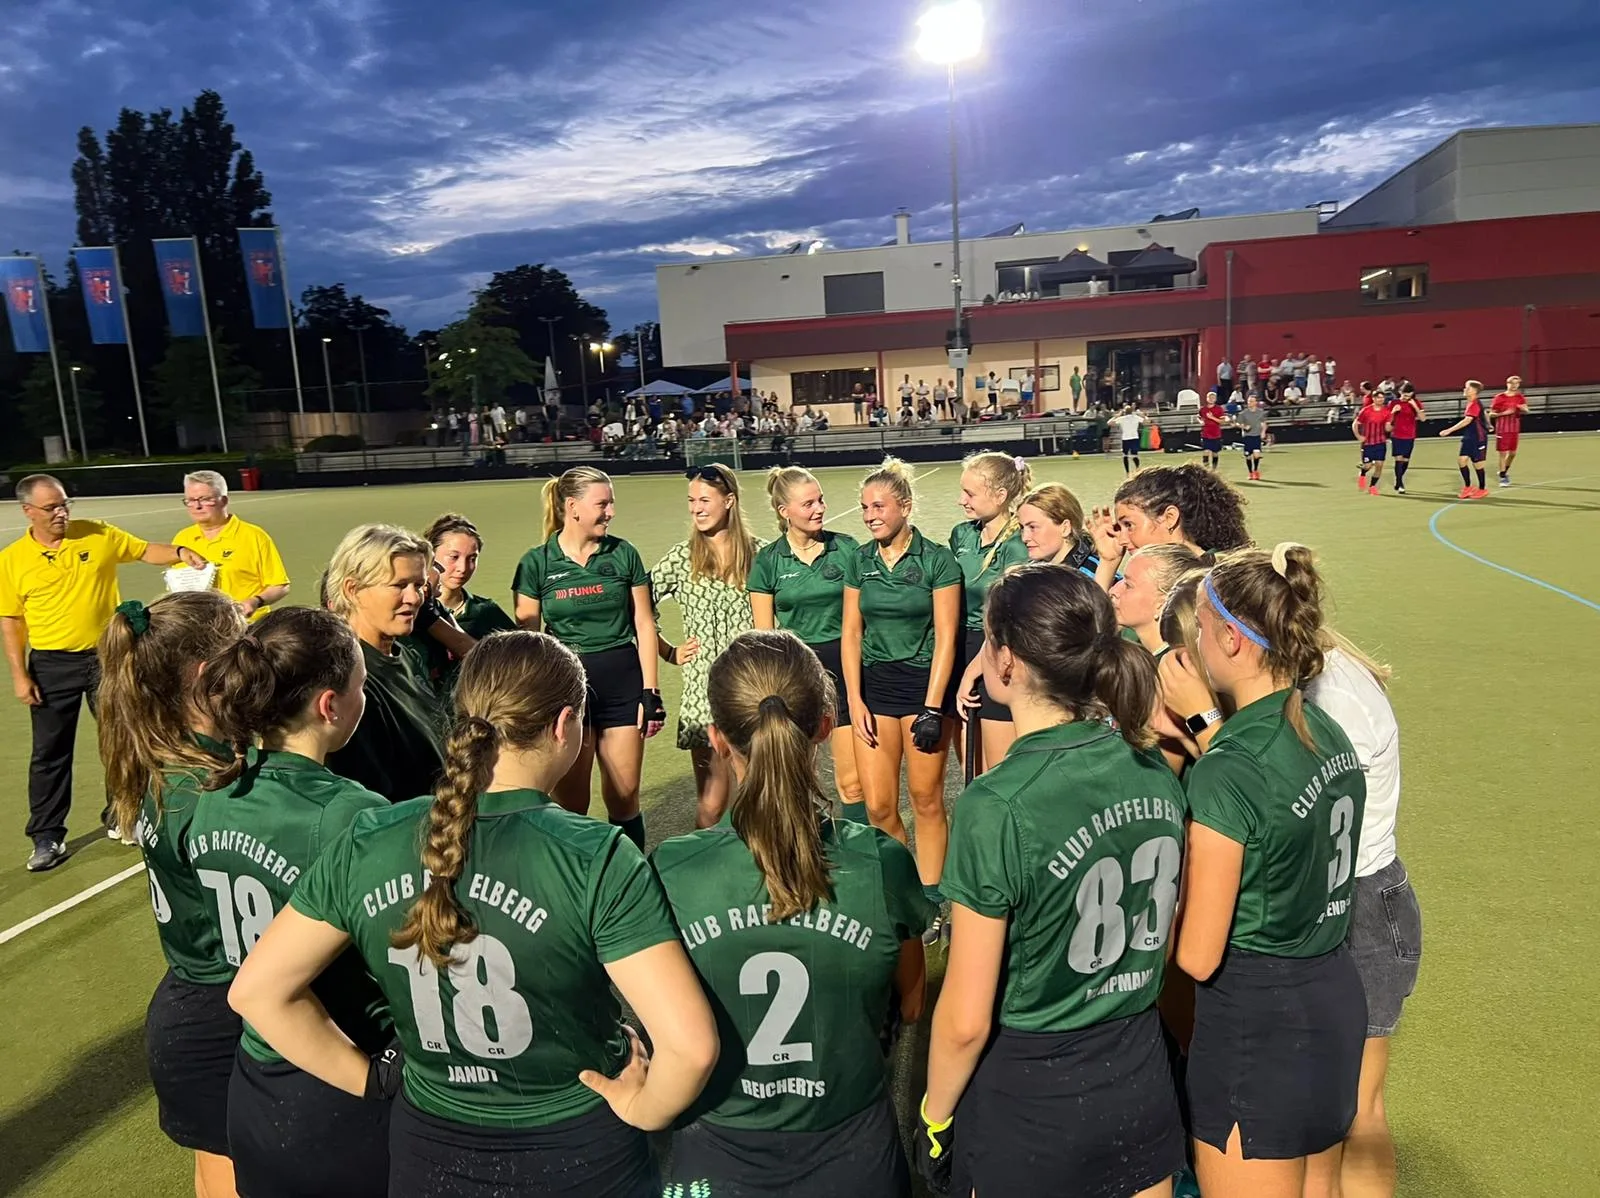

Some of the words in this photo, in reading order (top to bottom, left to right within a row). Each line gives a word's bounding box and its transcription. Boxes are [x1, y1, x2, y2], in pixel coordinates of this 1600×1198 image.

[569, 584, 604, 598] FUNKE
[1291, 775, 1323, 820] CLUB
[212, 829, 301, 886] RAFFELBERG
[1048, 825, 1093, 880] CLUB
[1328, 795, 1355, 894] 3
[363, 873, 415, 918] CLUB
[1067, 836, 1181, 974] 83
[681, 915, 722, 950] LUB
[1144, 936, 1160, 946] CR
[387, 934, 533, 1060] 18
[739, 951, 813, 1066] 2
[427, 1040, 442, 1050] CR
[488, 1047, 505, 1056] CR
[772, 1052, 790, 1062] CR
[741, 1077, 826, 1099] REICHERTS
